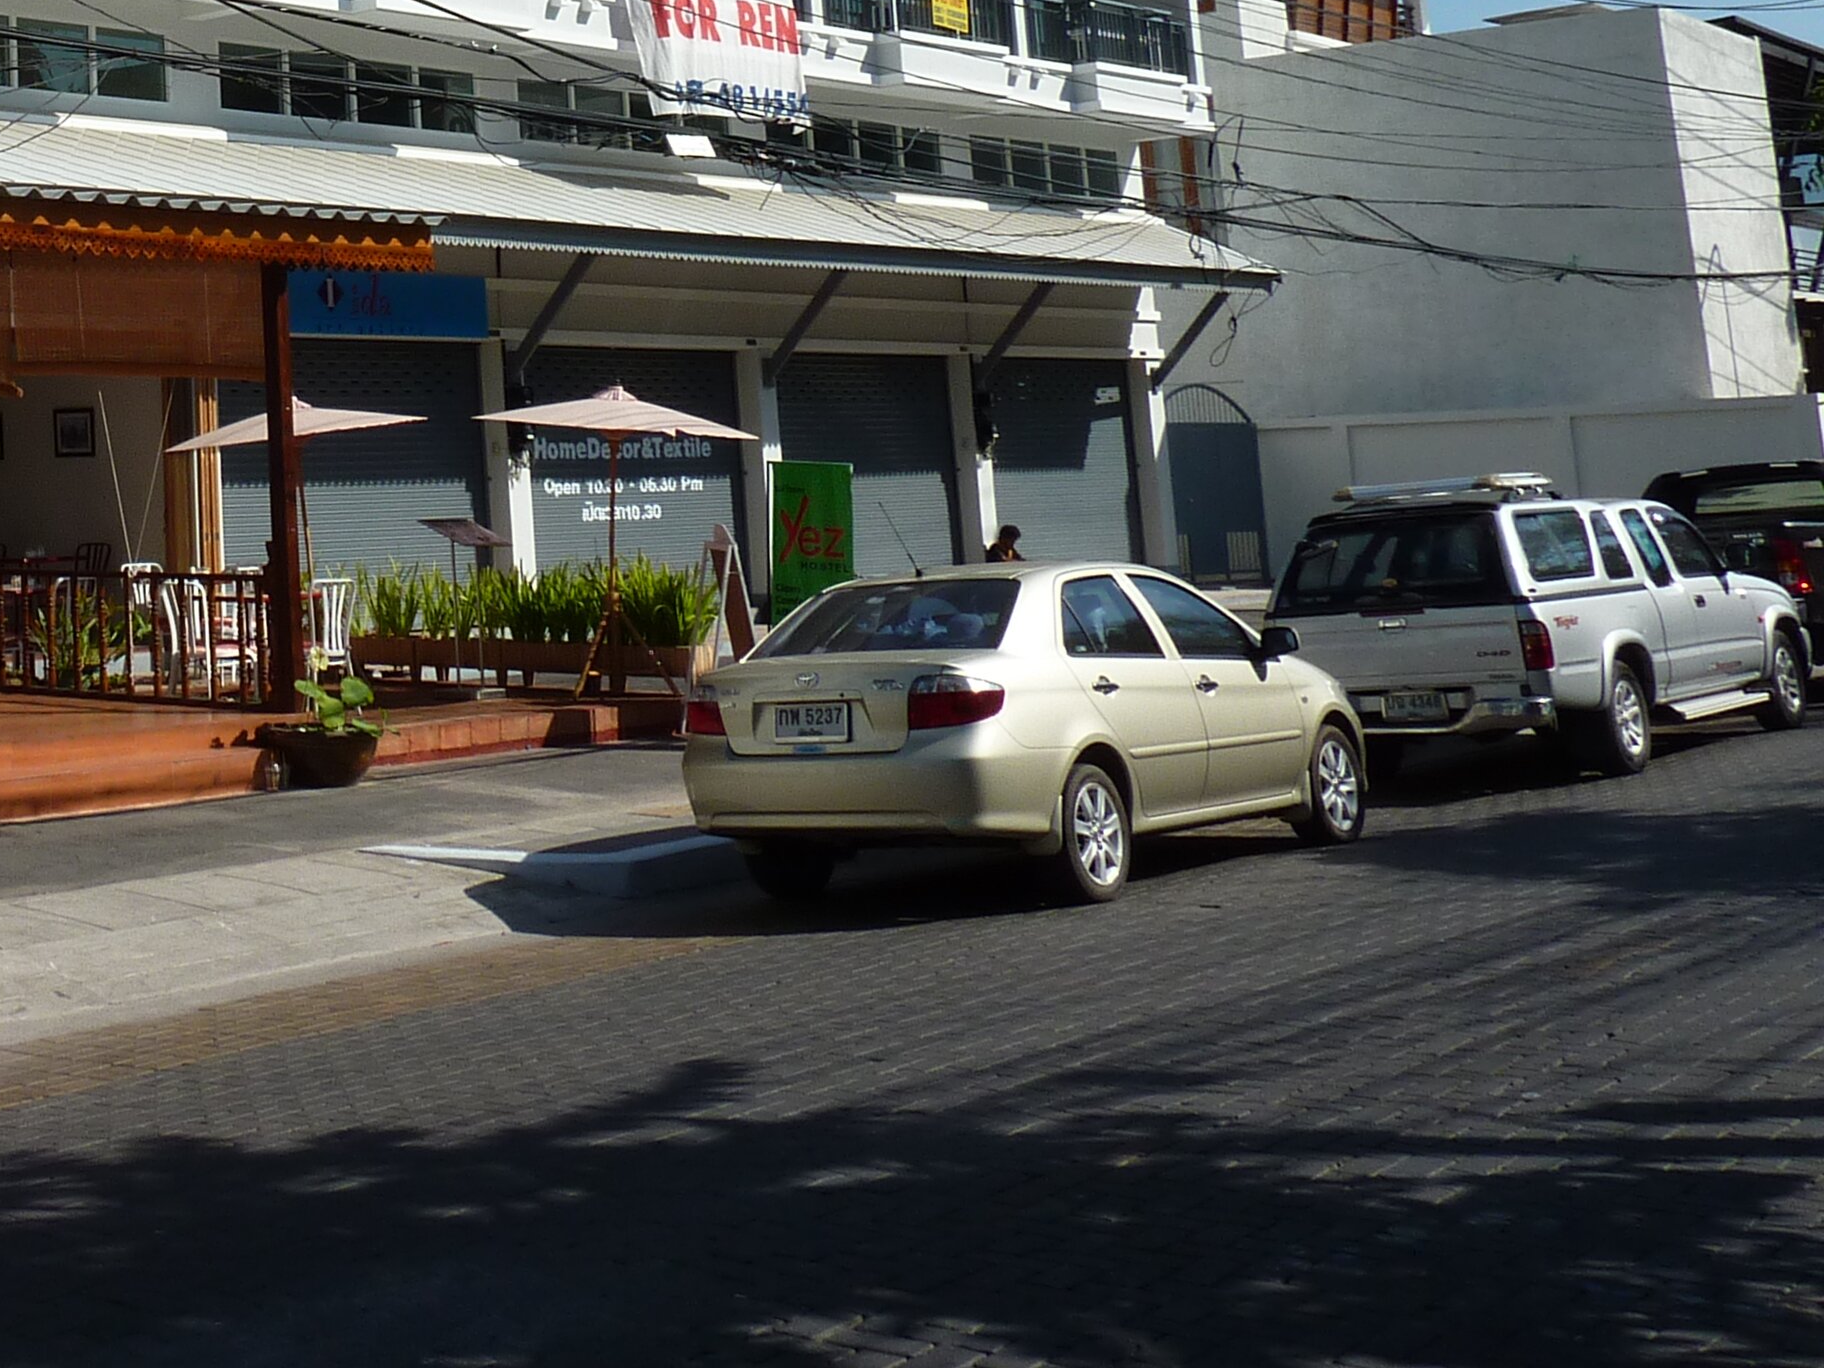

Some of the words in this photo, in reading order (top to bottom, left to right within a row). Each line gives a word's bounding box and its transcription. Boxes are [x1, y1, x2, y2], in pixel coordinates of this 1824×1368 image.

[533, 437, 713, 460] HomeDeor&Textile
[544, 478, 581, 499] Open
[681, 476, 704, 491] Pm
[779, 494, 845, 564] Yez
[800, 561, 850, 574] HOSTEL
[805, 707, 842, 725] 5237
